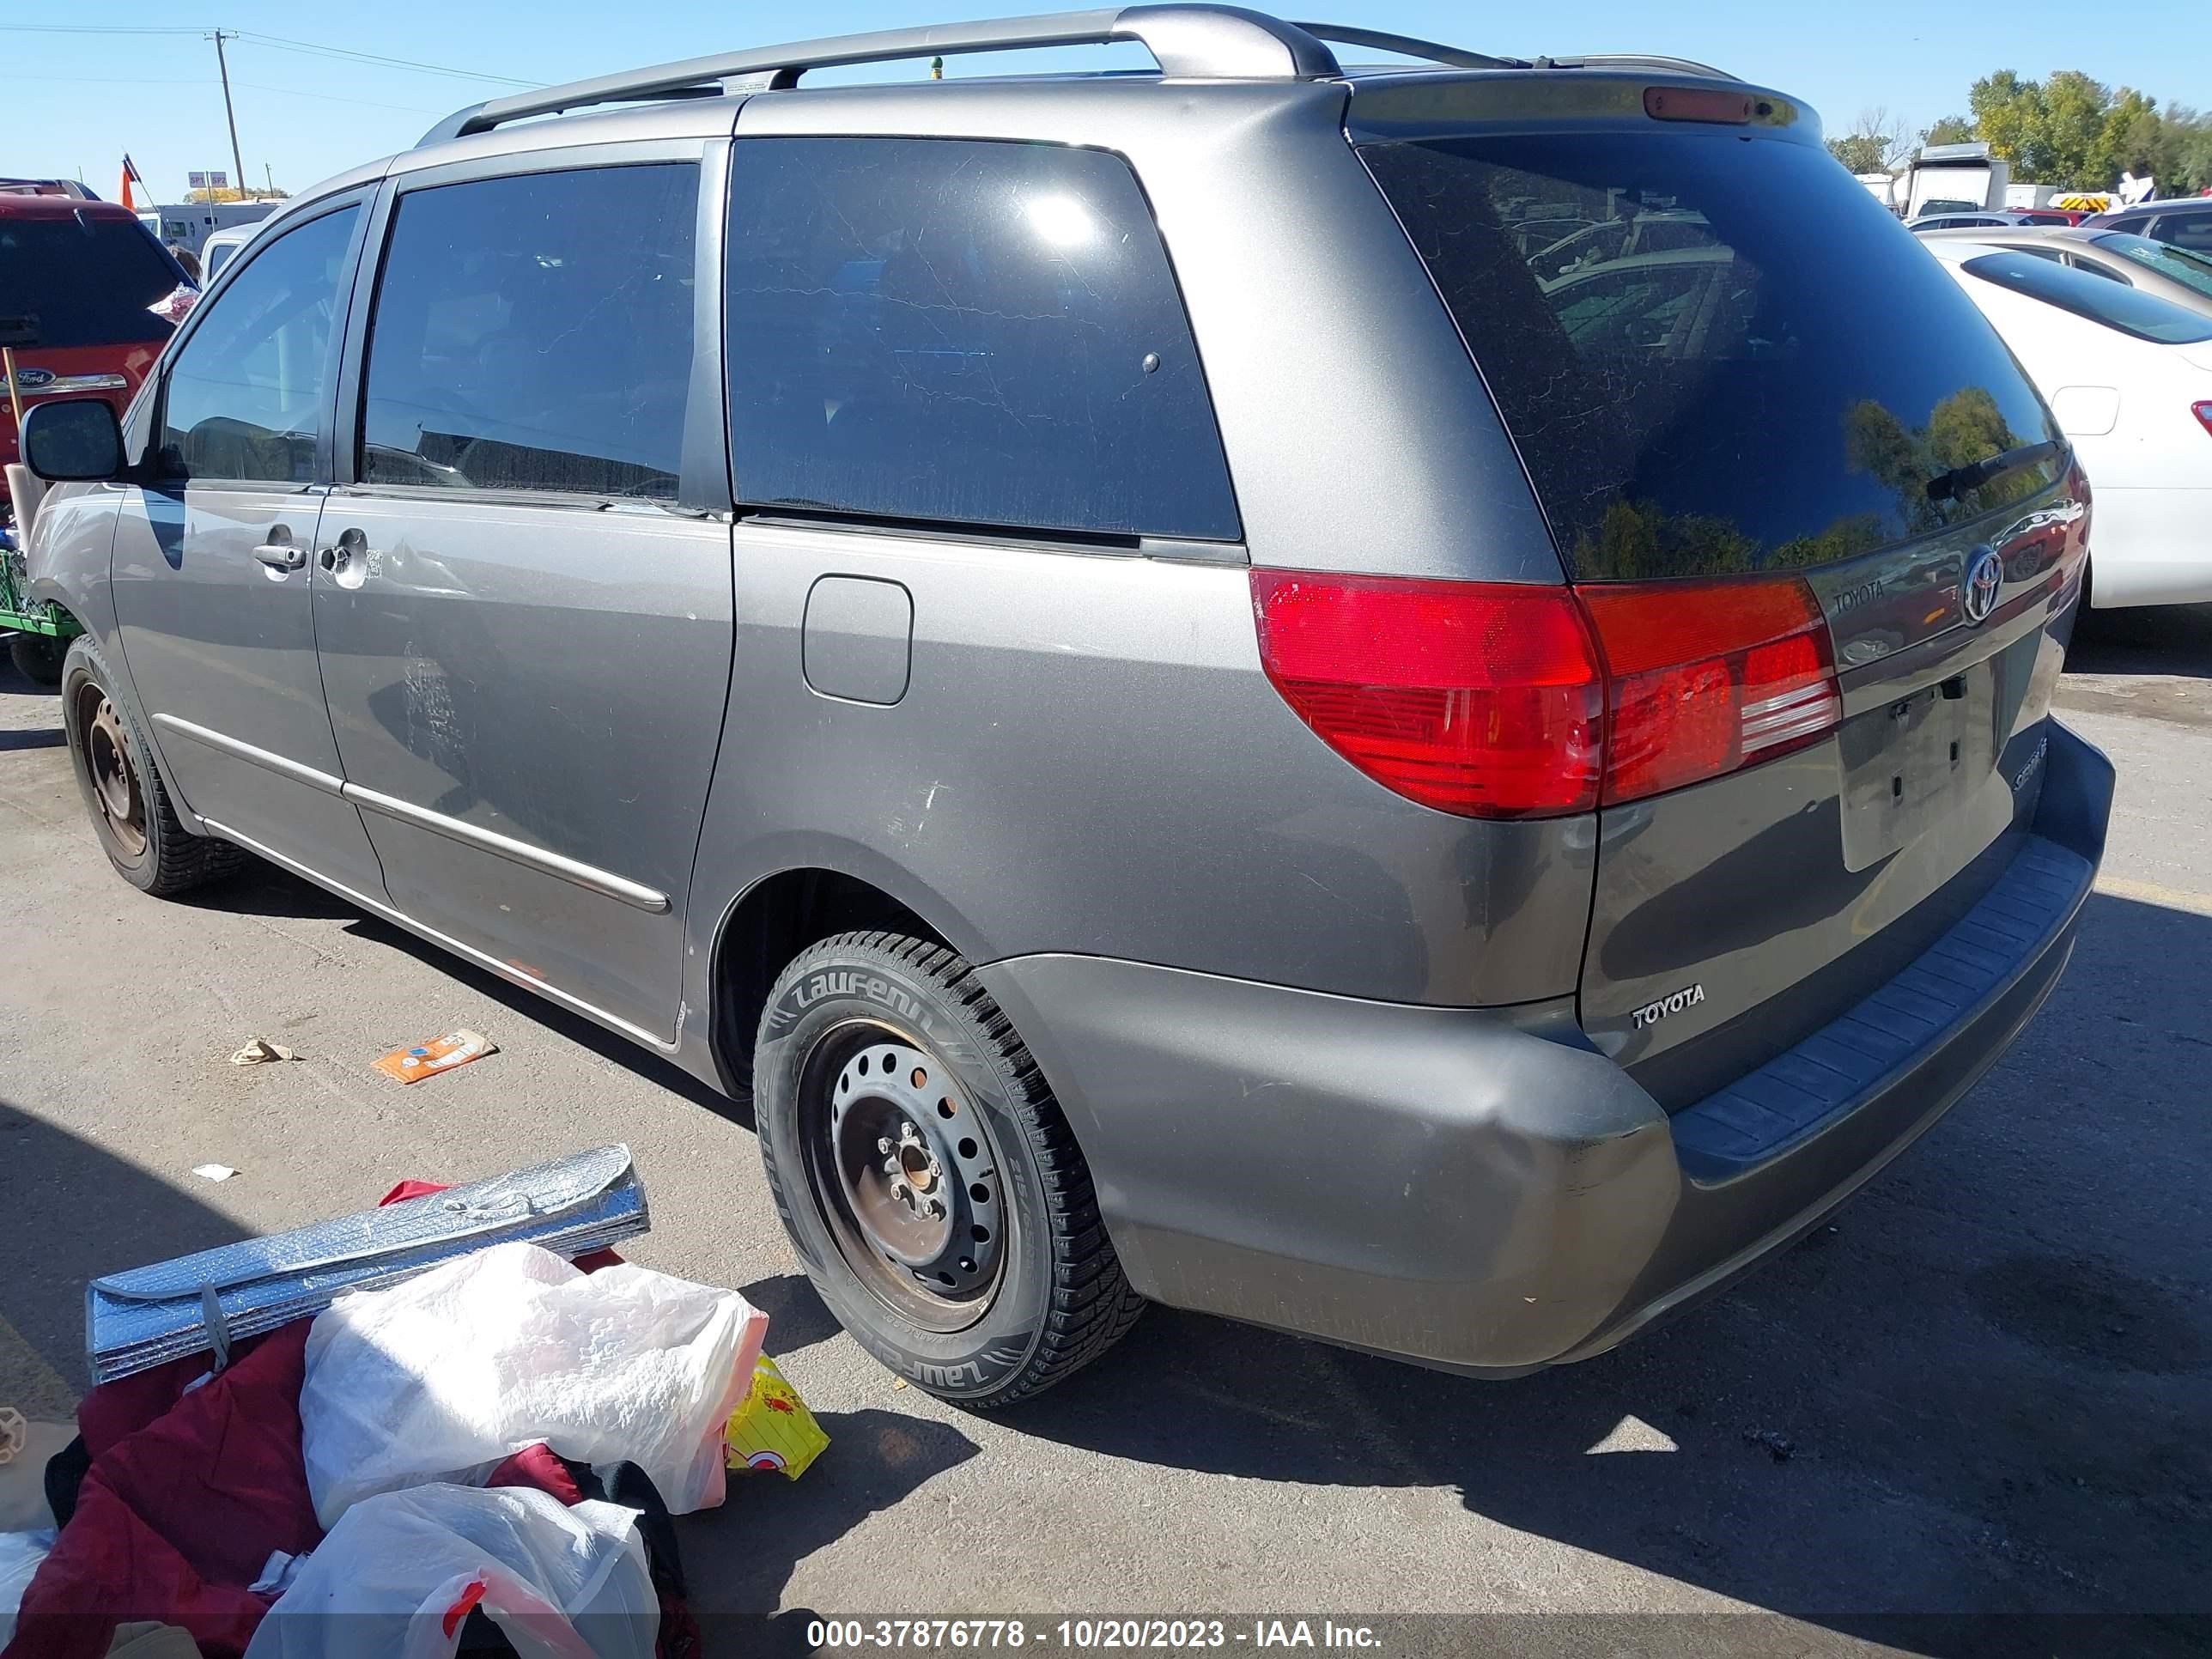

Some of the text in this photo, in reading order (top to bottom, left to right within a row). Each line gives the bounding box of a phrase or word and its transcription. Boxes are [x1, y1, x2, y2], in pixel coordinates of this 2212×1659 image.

[18, 371, 45, 384] Ford
[1833, 580, 1884, 614] TOYOTA
[1630, 983, 1705, 1030] TOYOTA
